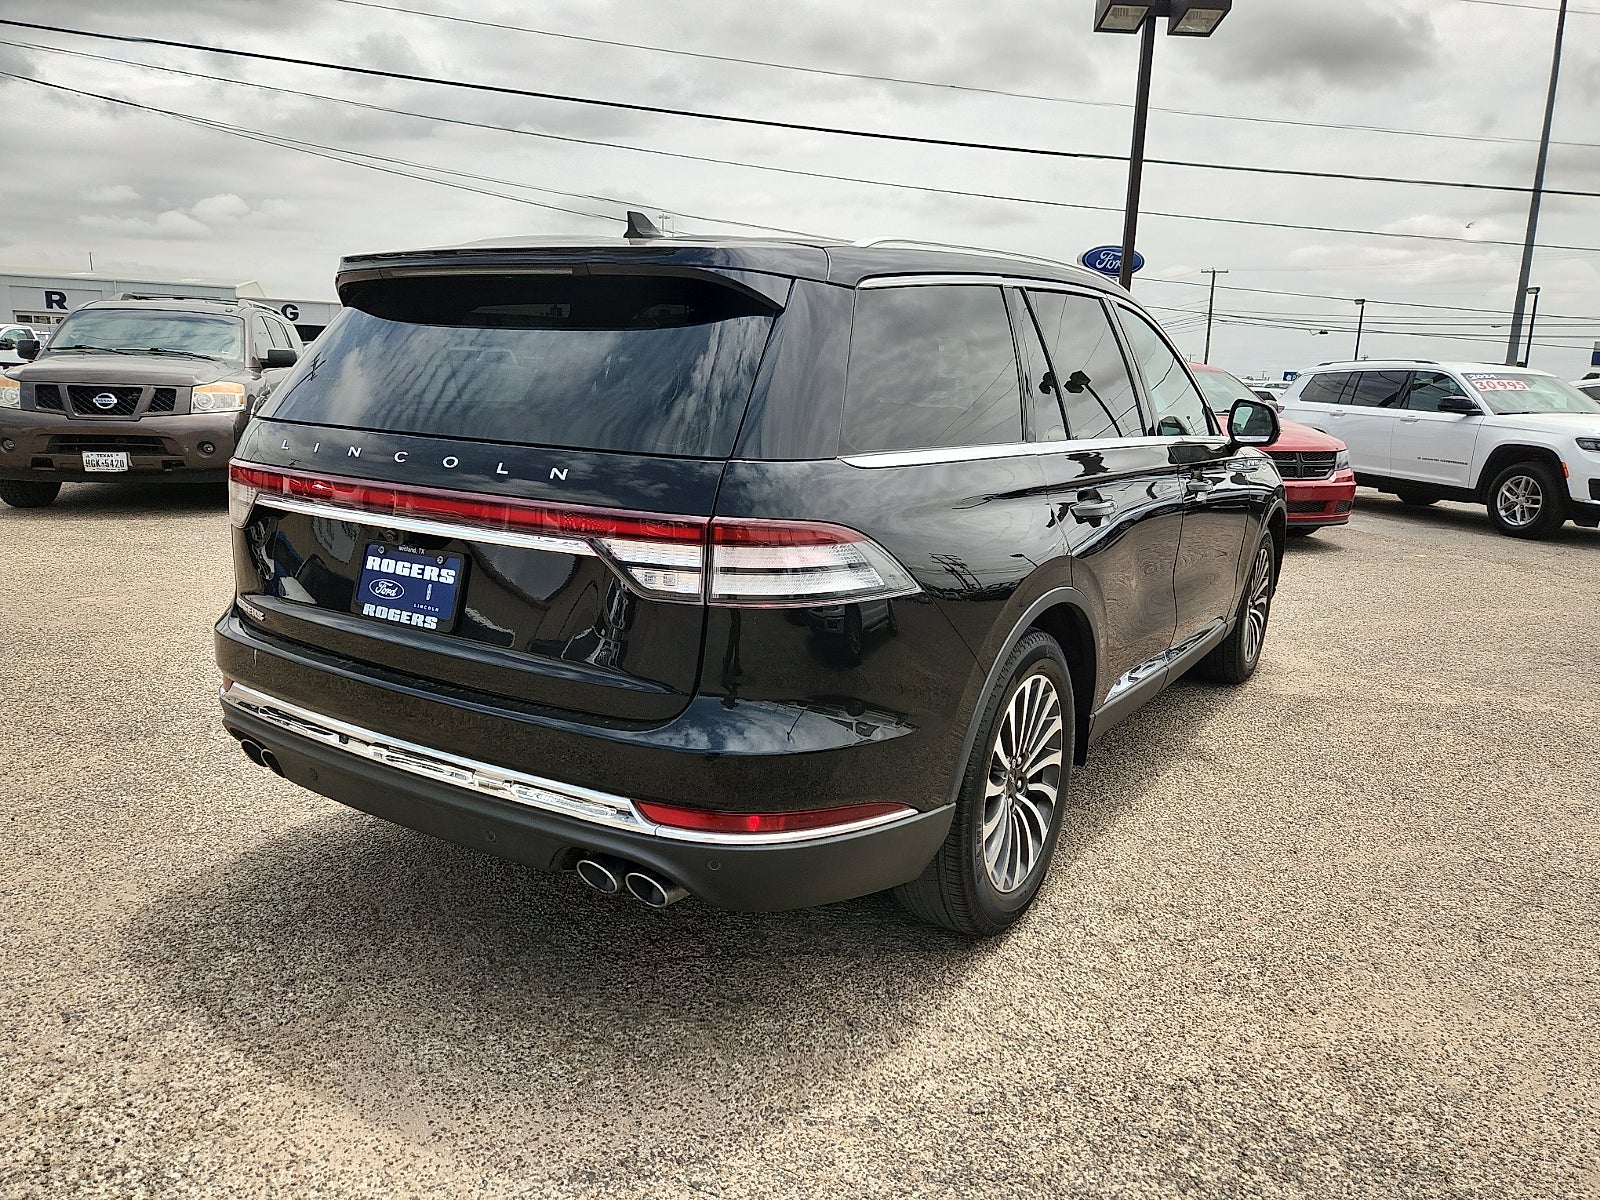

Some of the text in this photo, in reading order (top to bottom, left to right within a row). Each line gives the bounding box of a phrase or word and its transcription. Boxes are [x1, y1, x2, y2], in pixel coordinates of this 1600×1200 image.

[1096, 250, 1123, 270] For
[45, 290, 68, 310] R
[281, 304, 300, 321] G
[1475, 380, 1527, 390] 30995
[281, 439, 569, 481] LINCOLN
[365, 555, 456, 585] ROGERS
[375, 580, 400, 597] Ford
[362, 603, 438, 630] ROGERS
[413, 603, 440, 612] LINCOLN
